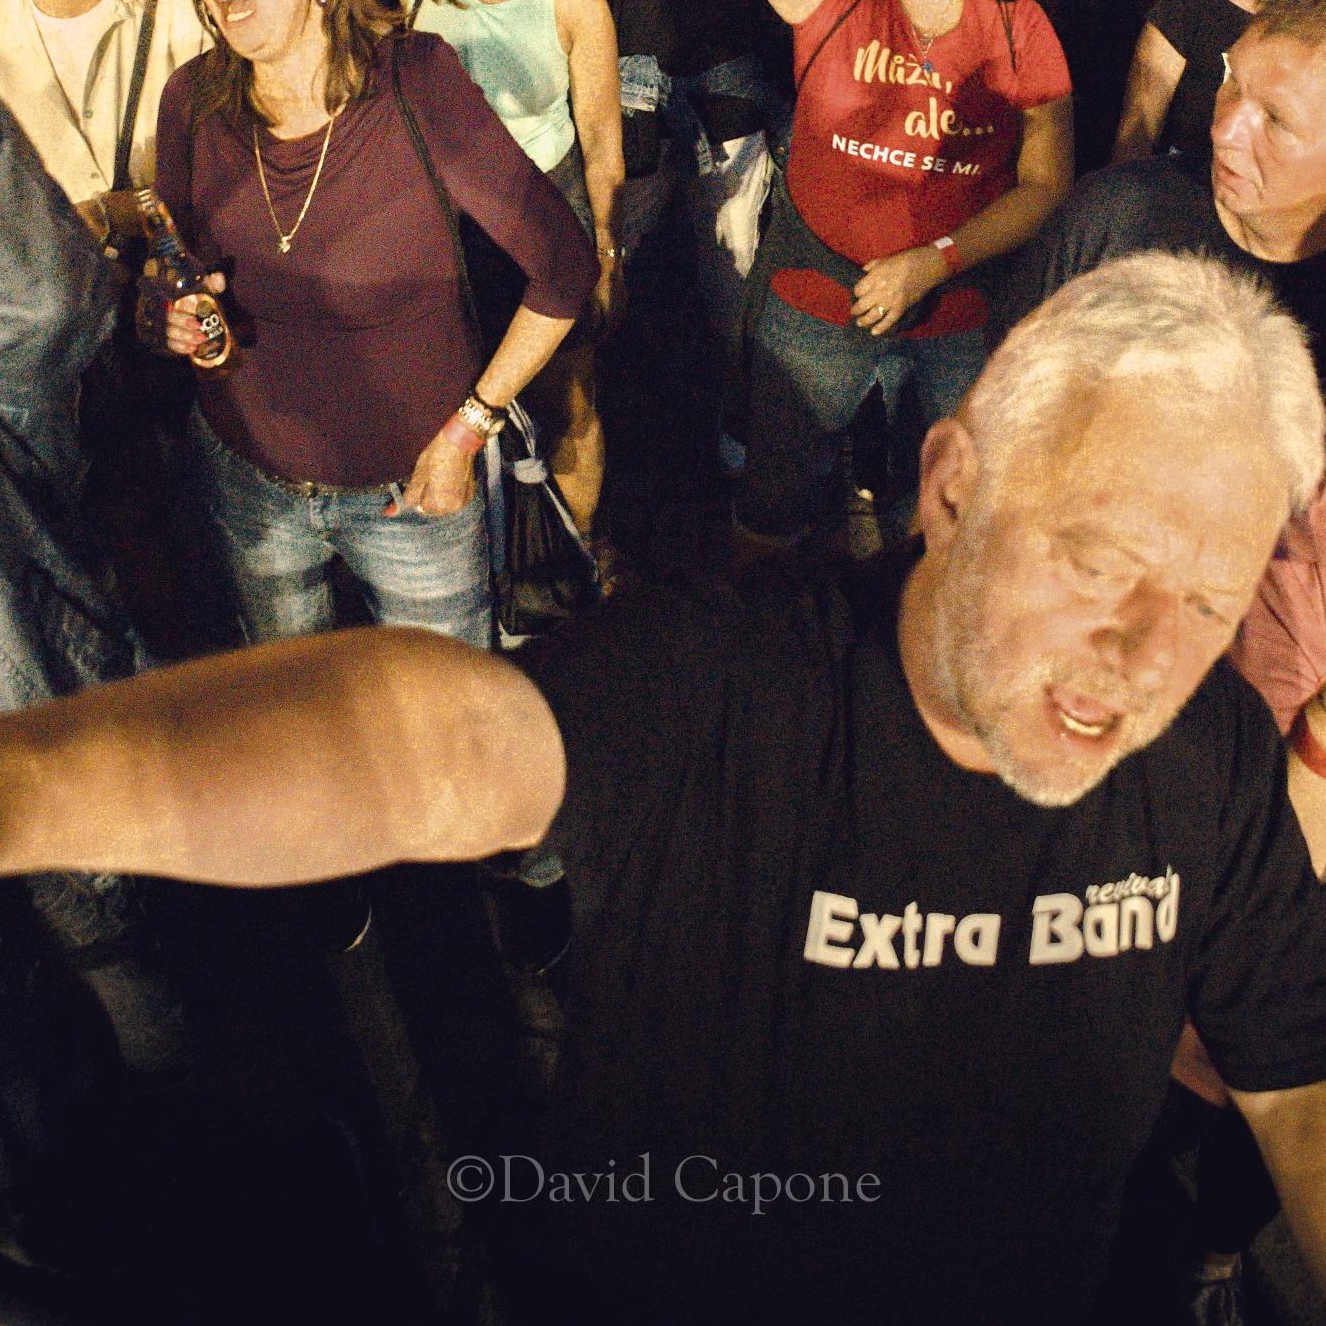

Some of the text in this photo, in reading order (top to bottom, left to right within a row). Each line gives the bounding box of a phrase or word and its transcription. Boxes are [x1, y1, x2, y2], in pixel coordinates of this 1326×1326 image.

[832, 133, 916, 168] NECHCE
[921, 155, 947, 172] SE
[802, 872, 1180, 971] Extra Band
